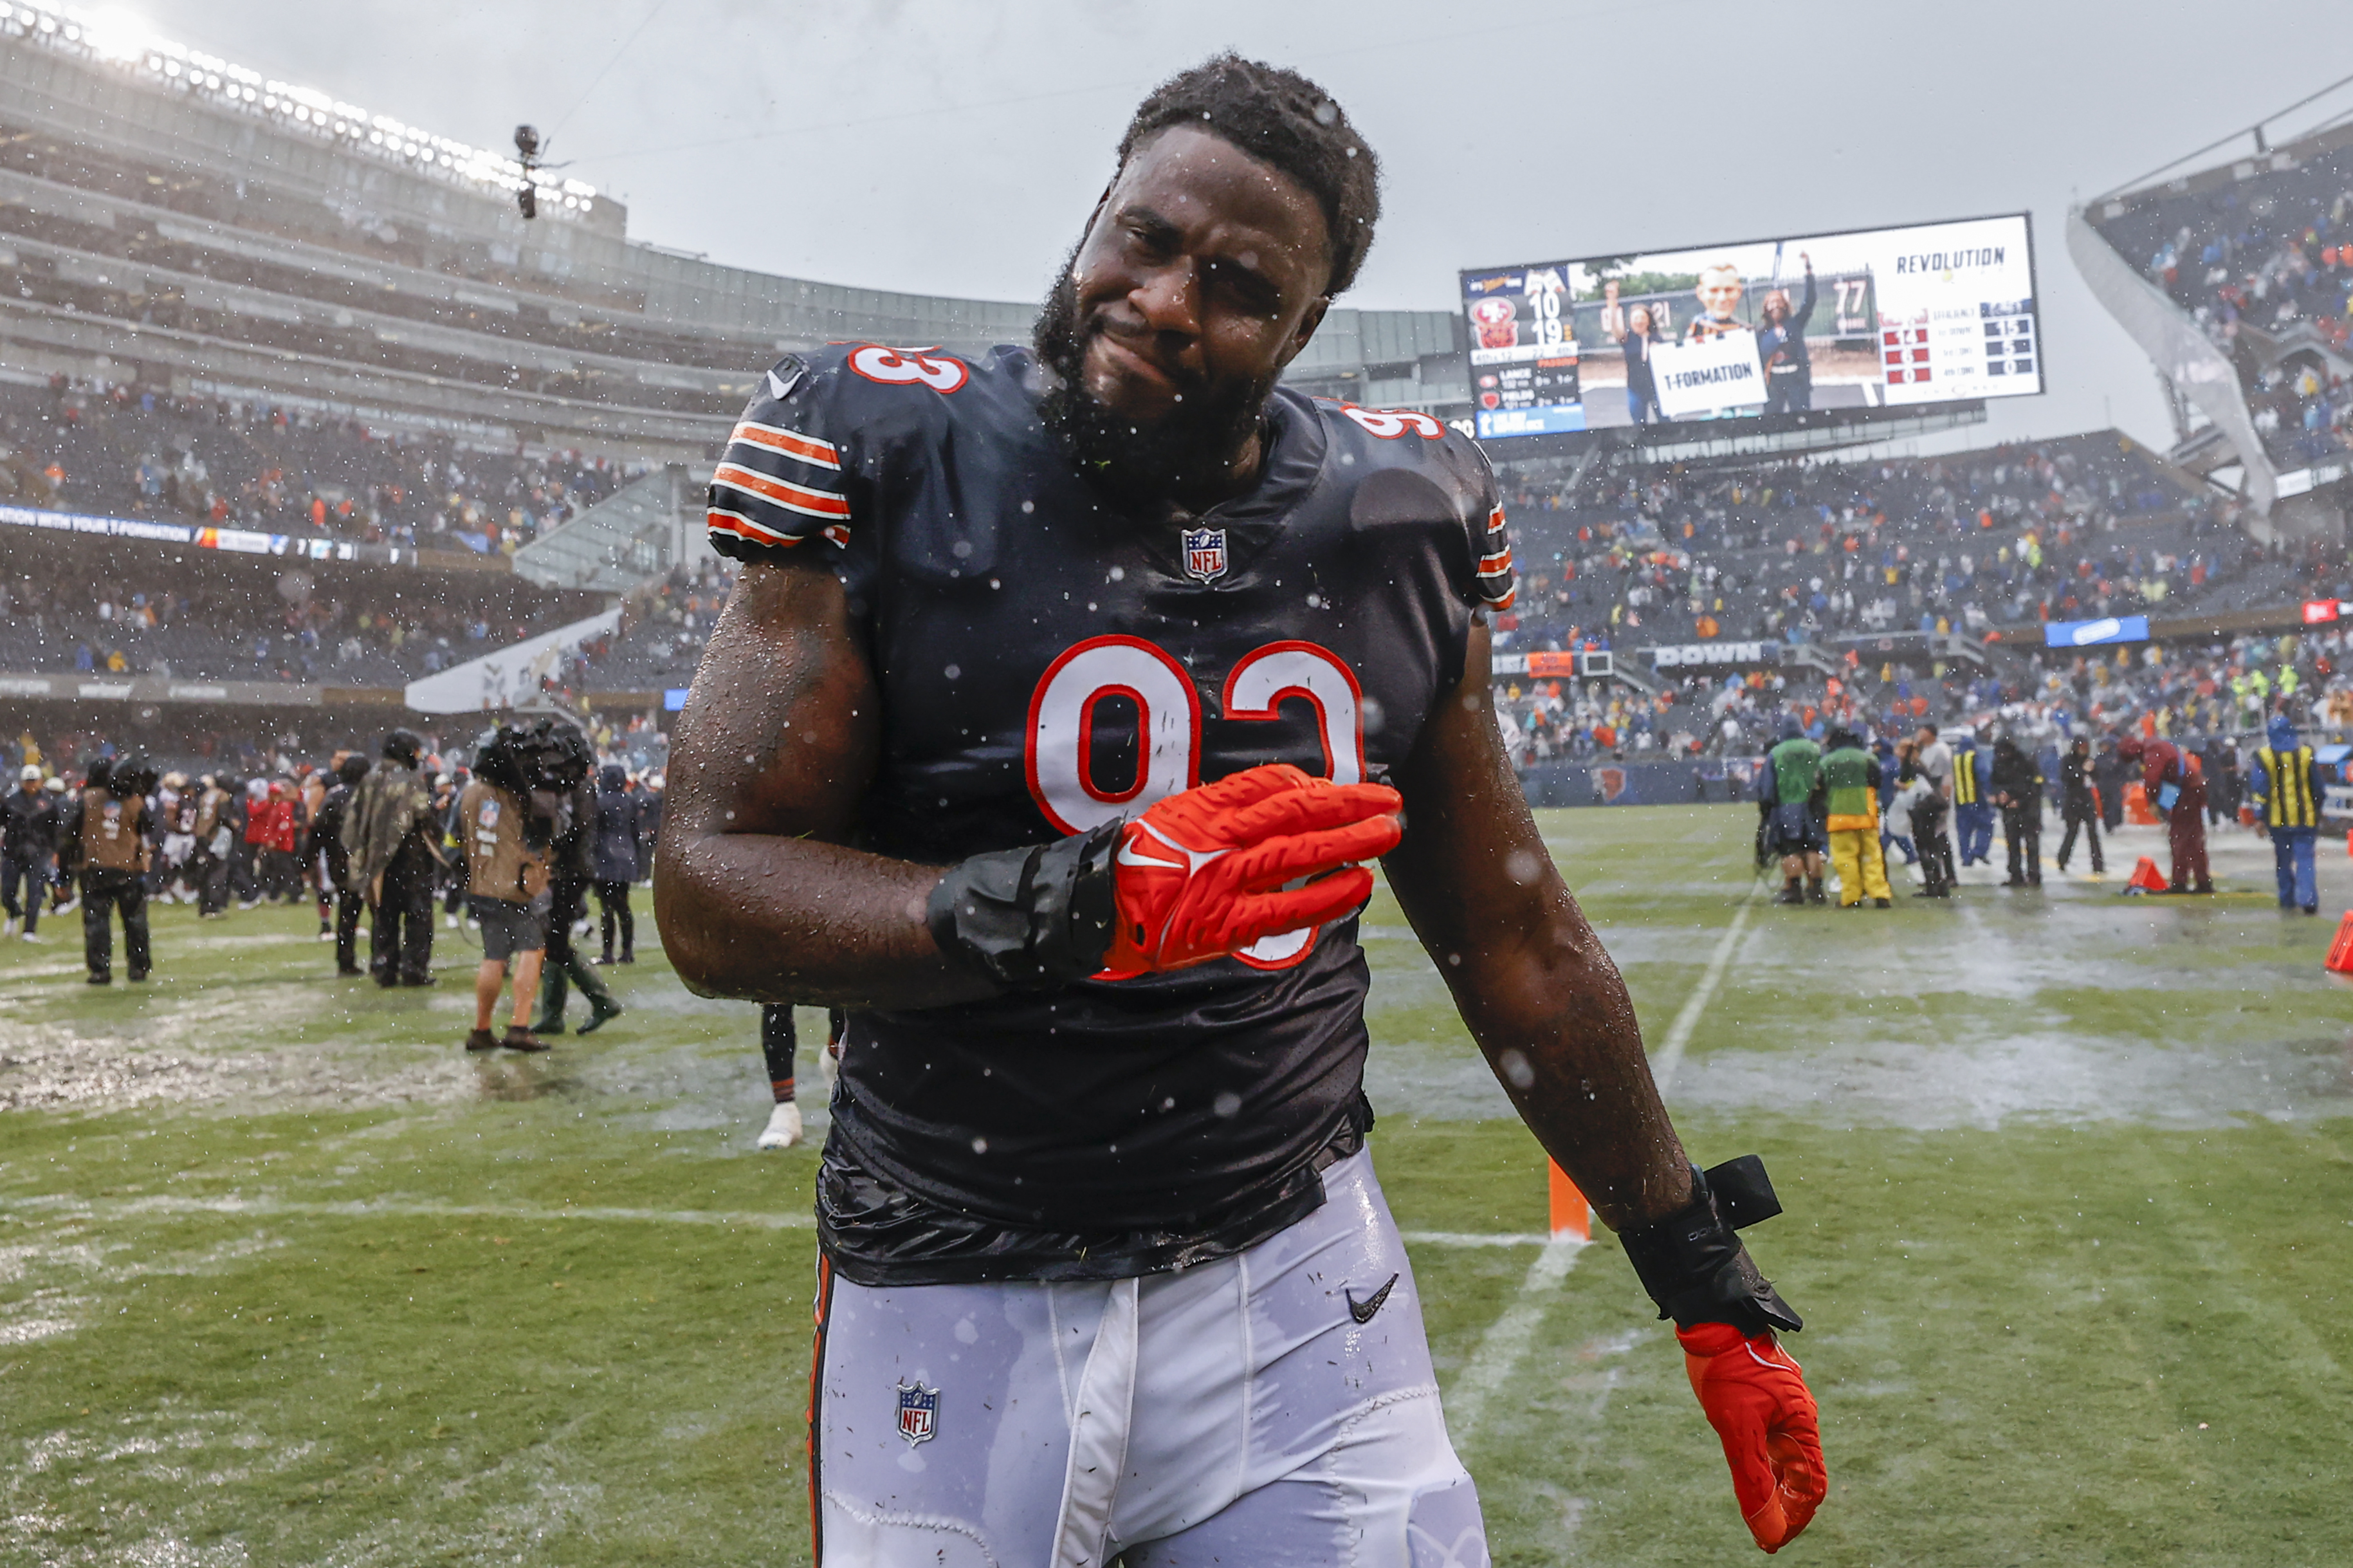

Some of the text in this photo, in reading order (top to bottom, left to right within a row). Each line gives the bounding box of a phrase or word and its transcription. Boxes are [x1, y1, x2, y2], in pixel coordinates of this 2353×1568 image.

[1897, 246, 2005, 275] REVOLUTION
[1529, 293, 1561, 319] 10
[1832, 280, 1867, 315] 77
[1531, 318, 1563, 345] 19
[1664, 361, 1754, 392] T-FORMATION
[1190, 551, 1222, 573] NFL
[1654, 641, 1761, 667] DOWN
[902, 1409, 929, 1435] NFL
